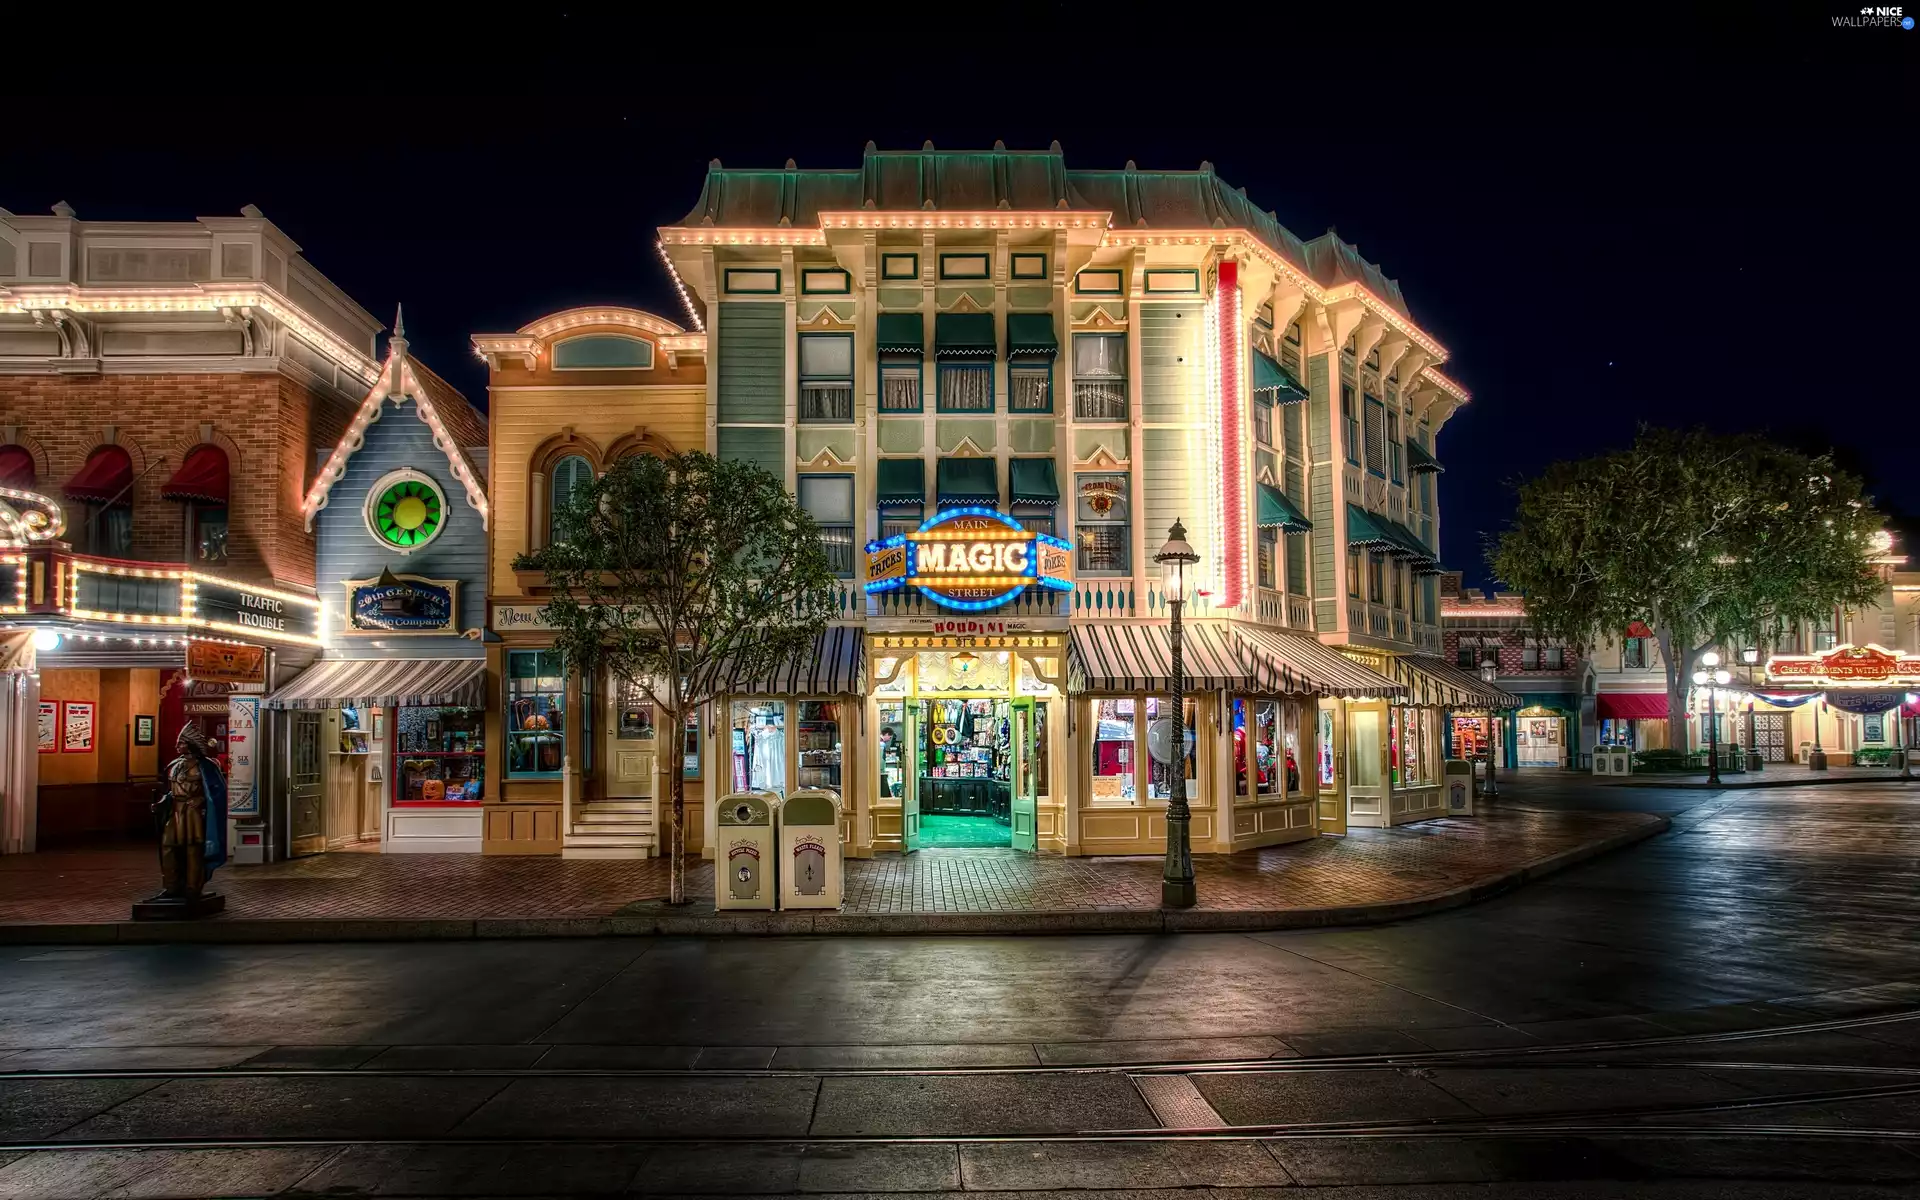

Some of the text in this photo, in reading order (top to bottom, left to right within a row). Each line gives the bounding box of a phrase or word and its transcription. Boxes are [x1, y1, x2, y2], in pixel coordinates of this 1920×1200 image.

[954, 520, 988, 529] MAIN
[870, 551, 902, 577] TRICKS
[916, 542, 1028, 572] MAGIC
[1044, 555, 1066, 570] JOKES
[358, 592, 384, 607] 20th
[948, 588, 996, 597] STREET
[240, 592, 282, 613] TRAFFIC
[237, 611, 285, 631] TROUBLE
[395, 618, 447, 627] Company
[934, 621, 1004, 634] HOUDINI
[1855, 666, 1879, 674] WITH
